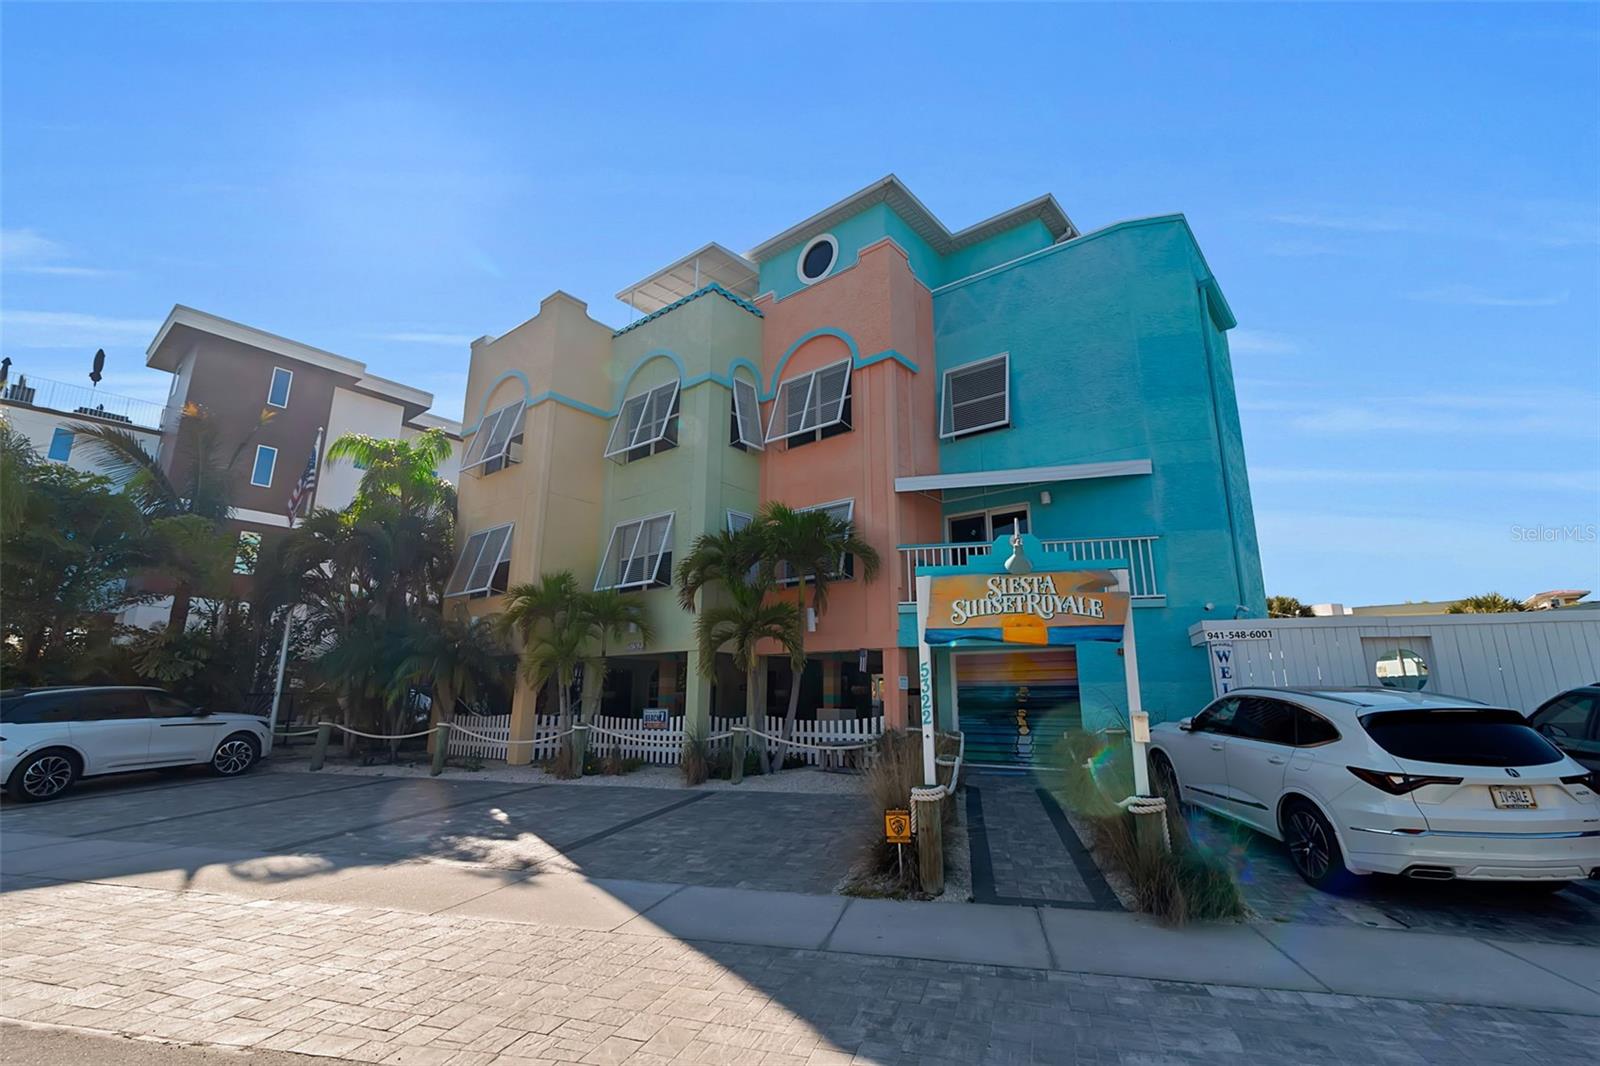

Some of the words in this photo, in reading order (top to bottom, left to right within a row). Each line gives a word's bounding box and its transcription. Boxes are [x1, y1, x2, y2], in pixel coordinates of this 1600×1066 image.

[987, 575, 1057, 600] SIESTA
[1207, 630, 1273, 640] 941-548-6001
[920, 662, 932, 725] 5322
